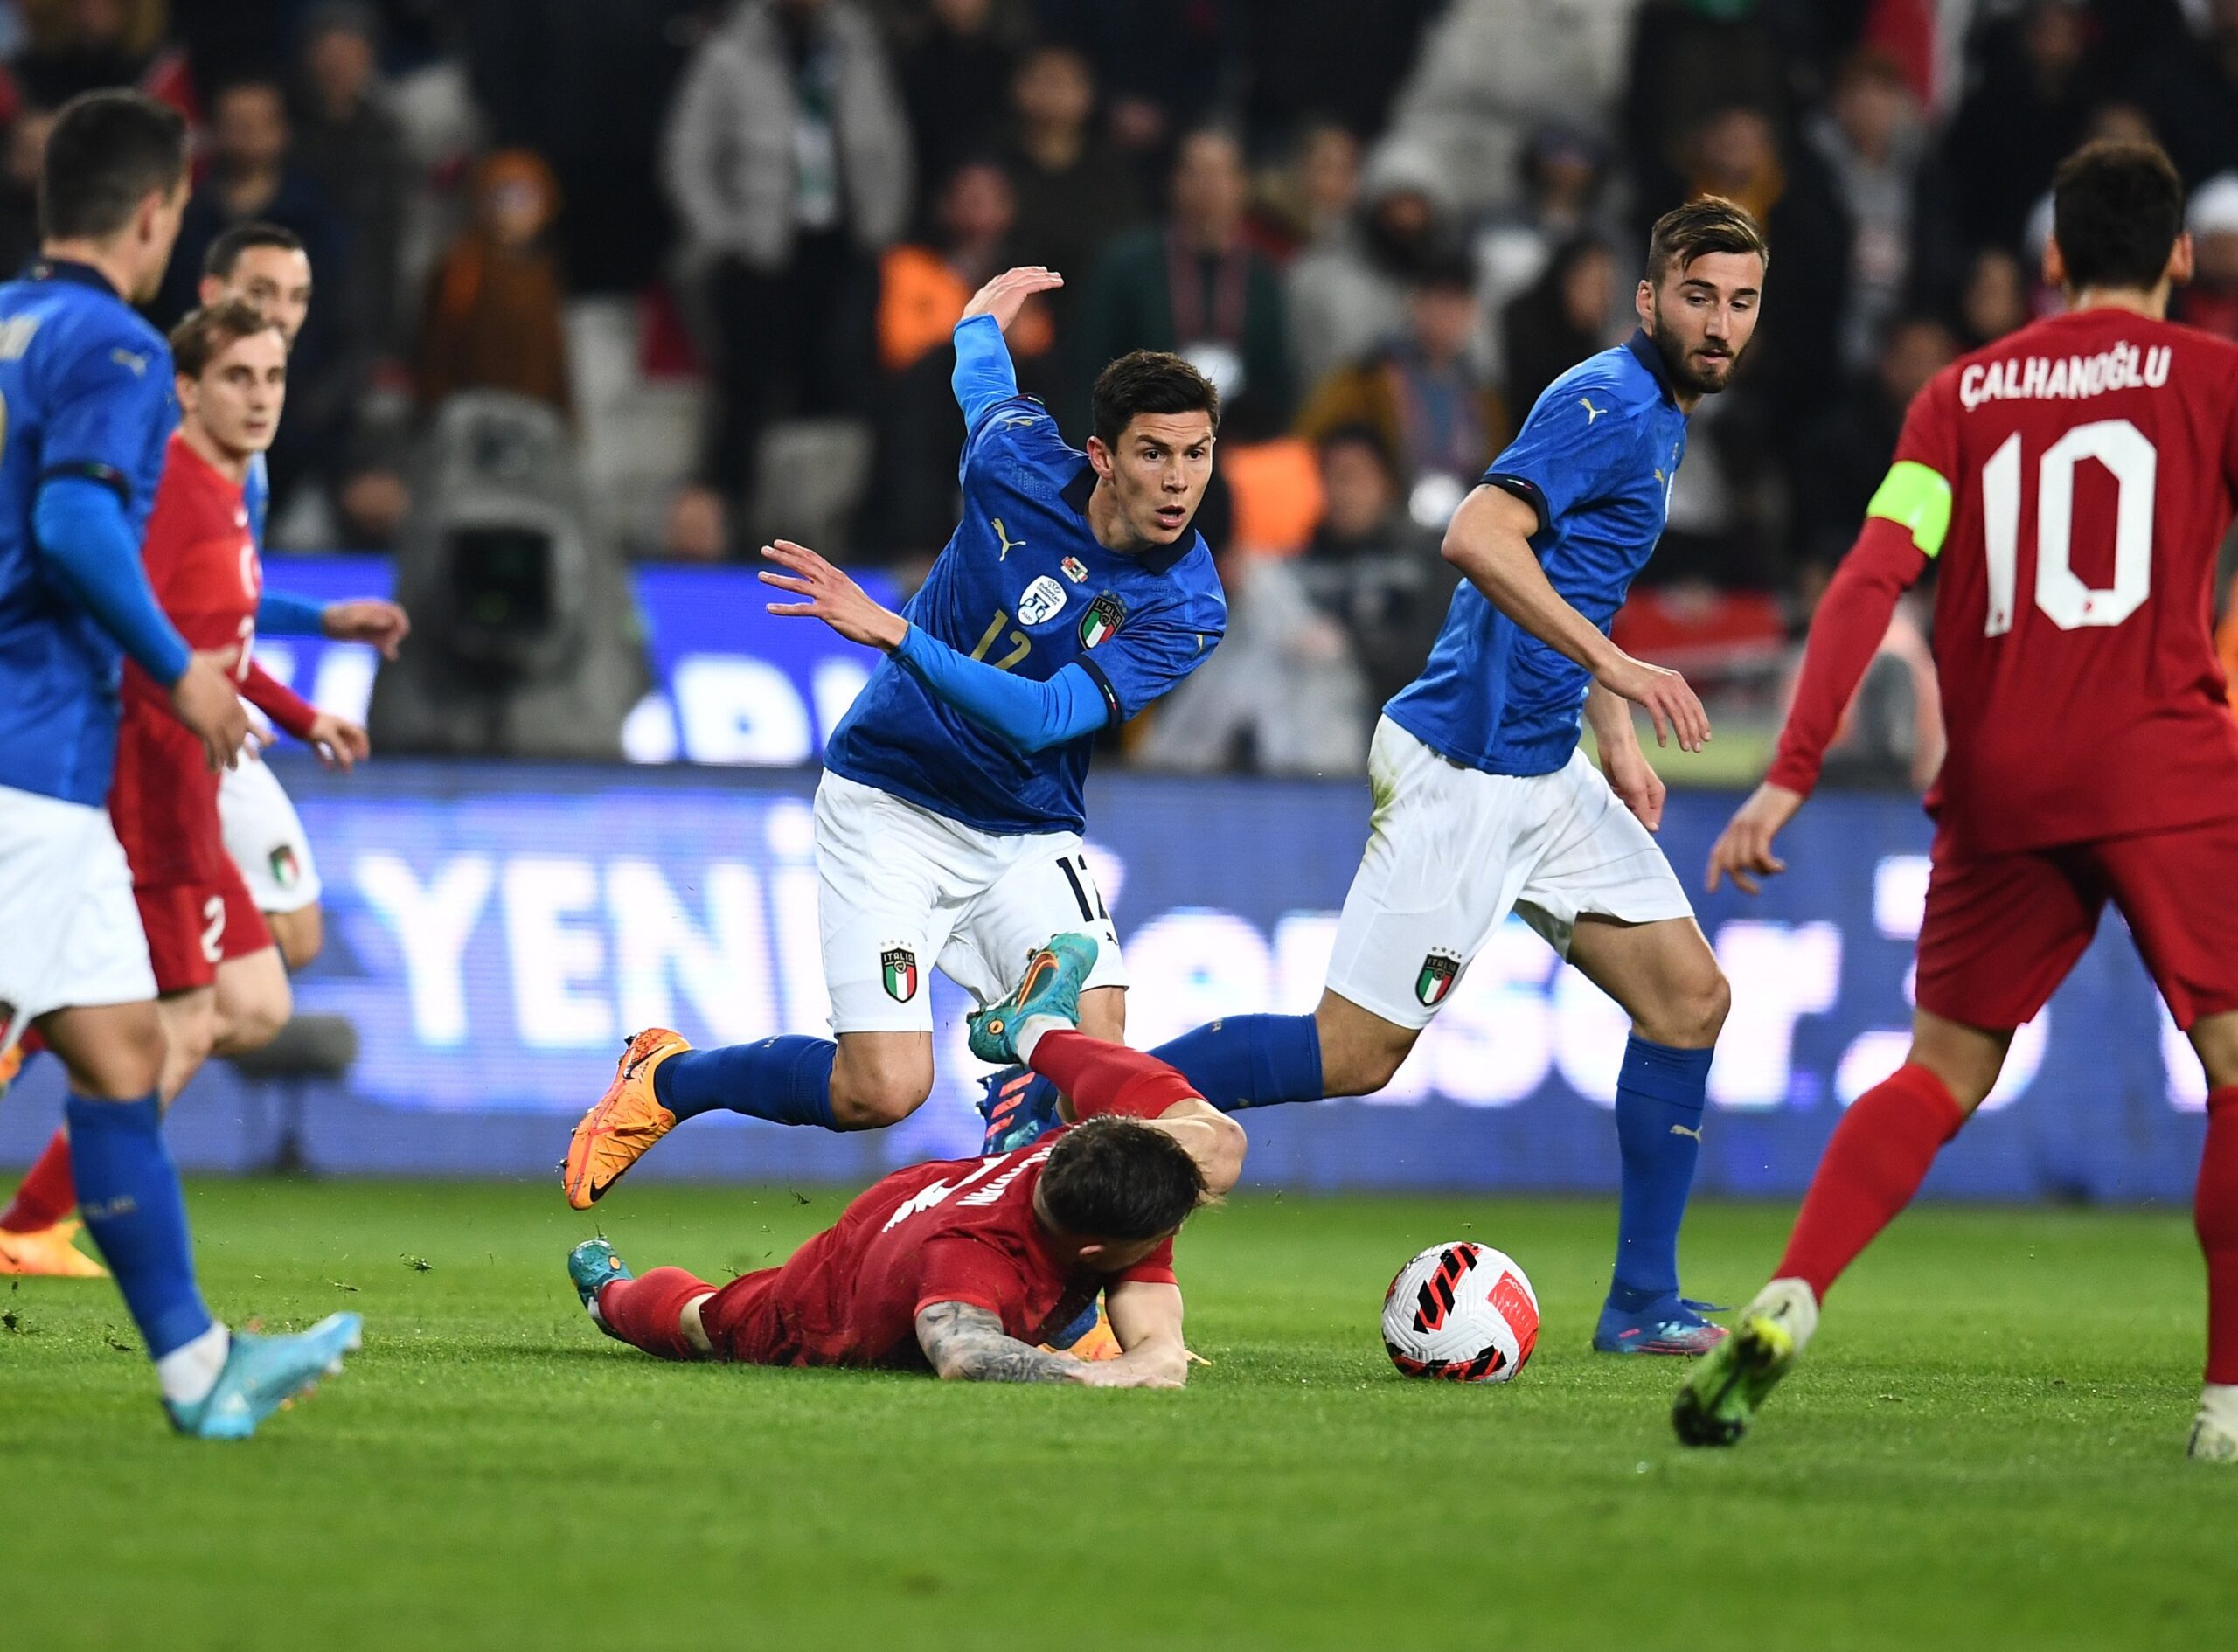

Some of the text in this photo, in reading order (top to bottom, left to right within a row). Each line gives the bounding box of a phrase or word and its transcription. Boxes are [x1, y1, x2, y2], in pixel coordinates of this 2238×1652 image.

[1959, 340, 2172, 413] ÇALHANOĞLU
[1982, 418, 2158, 637] 10
[968, 608, 1032, 670] 12
[1095, 599, 1122, 624] ITALIA
[200, 894, 226, 963] 2
[883, 951, 914, 962] ITALIA
